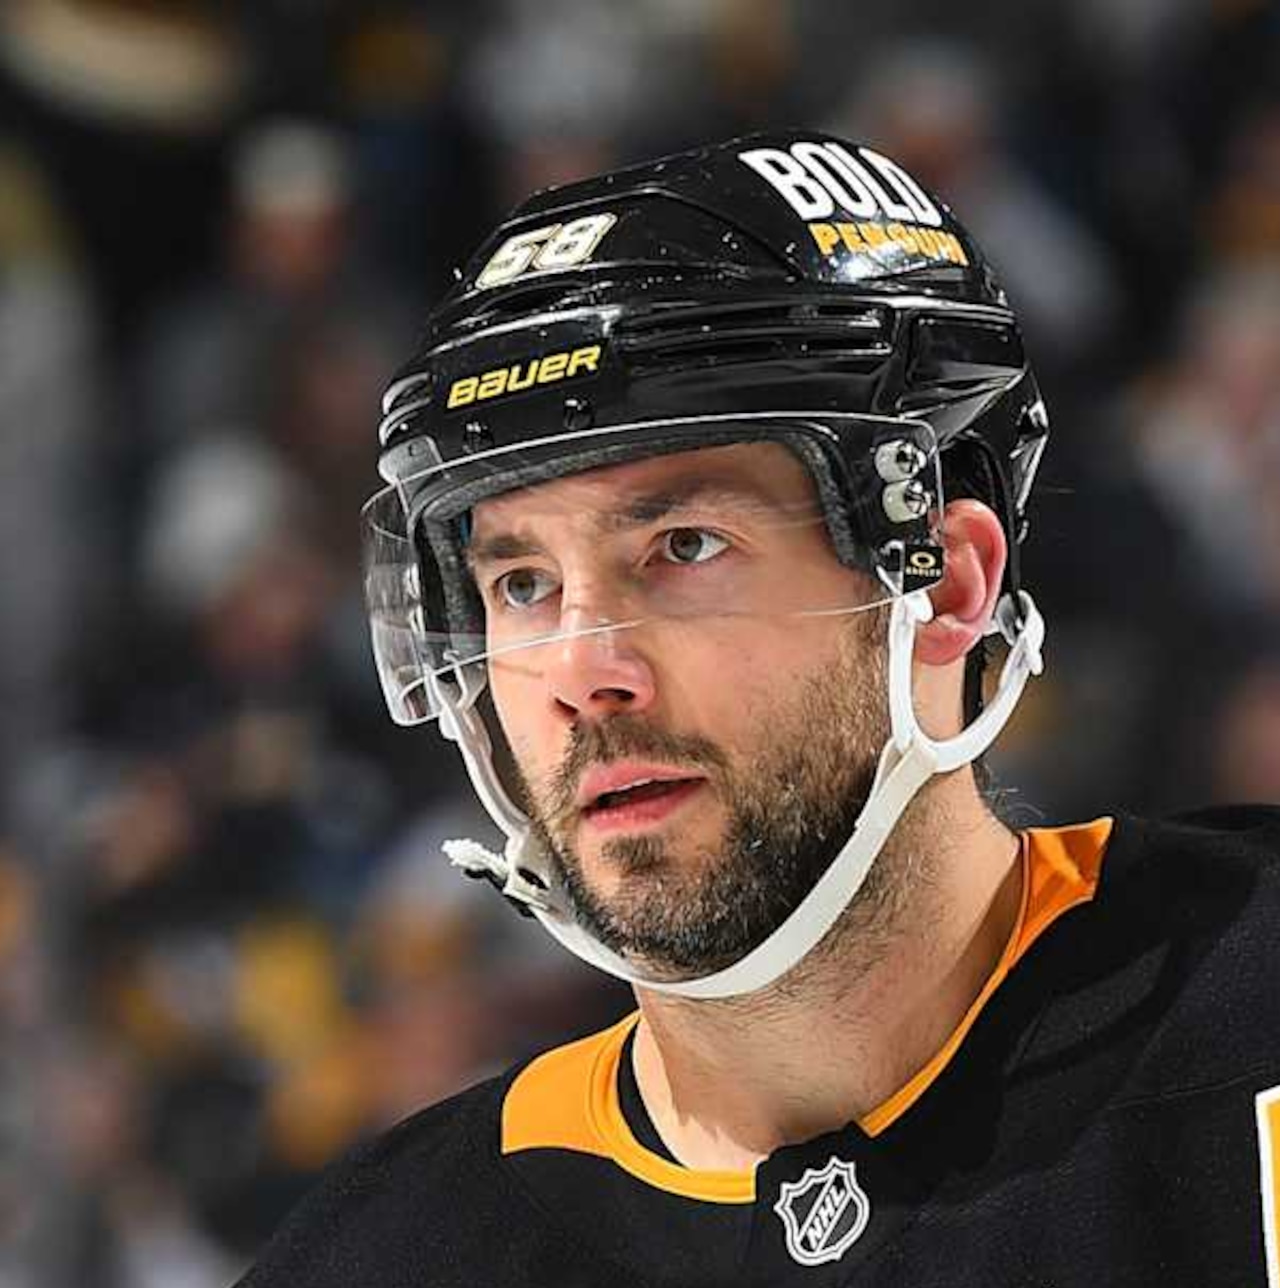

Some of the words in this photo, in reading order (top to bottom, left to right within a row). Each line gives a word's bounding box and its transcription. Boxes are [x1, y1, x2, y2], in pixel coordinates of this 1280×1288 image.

[737, 142, 943, 227] BOLD
[475, 211, 618, 290] 58
[447, 344, 601, 409] BAUER
[806, 1183, 847, 1251] NHL
